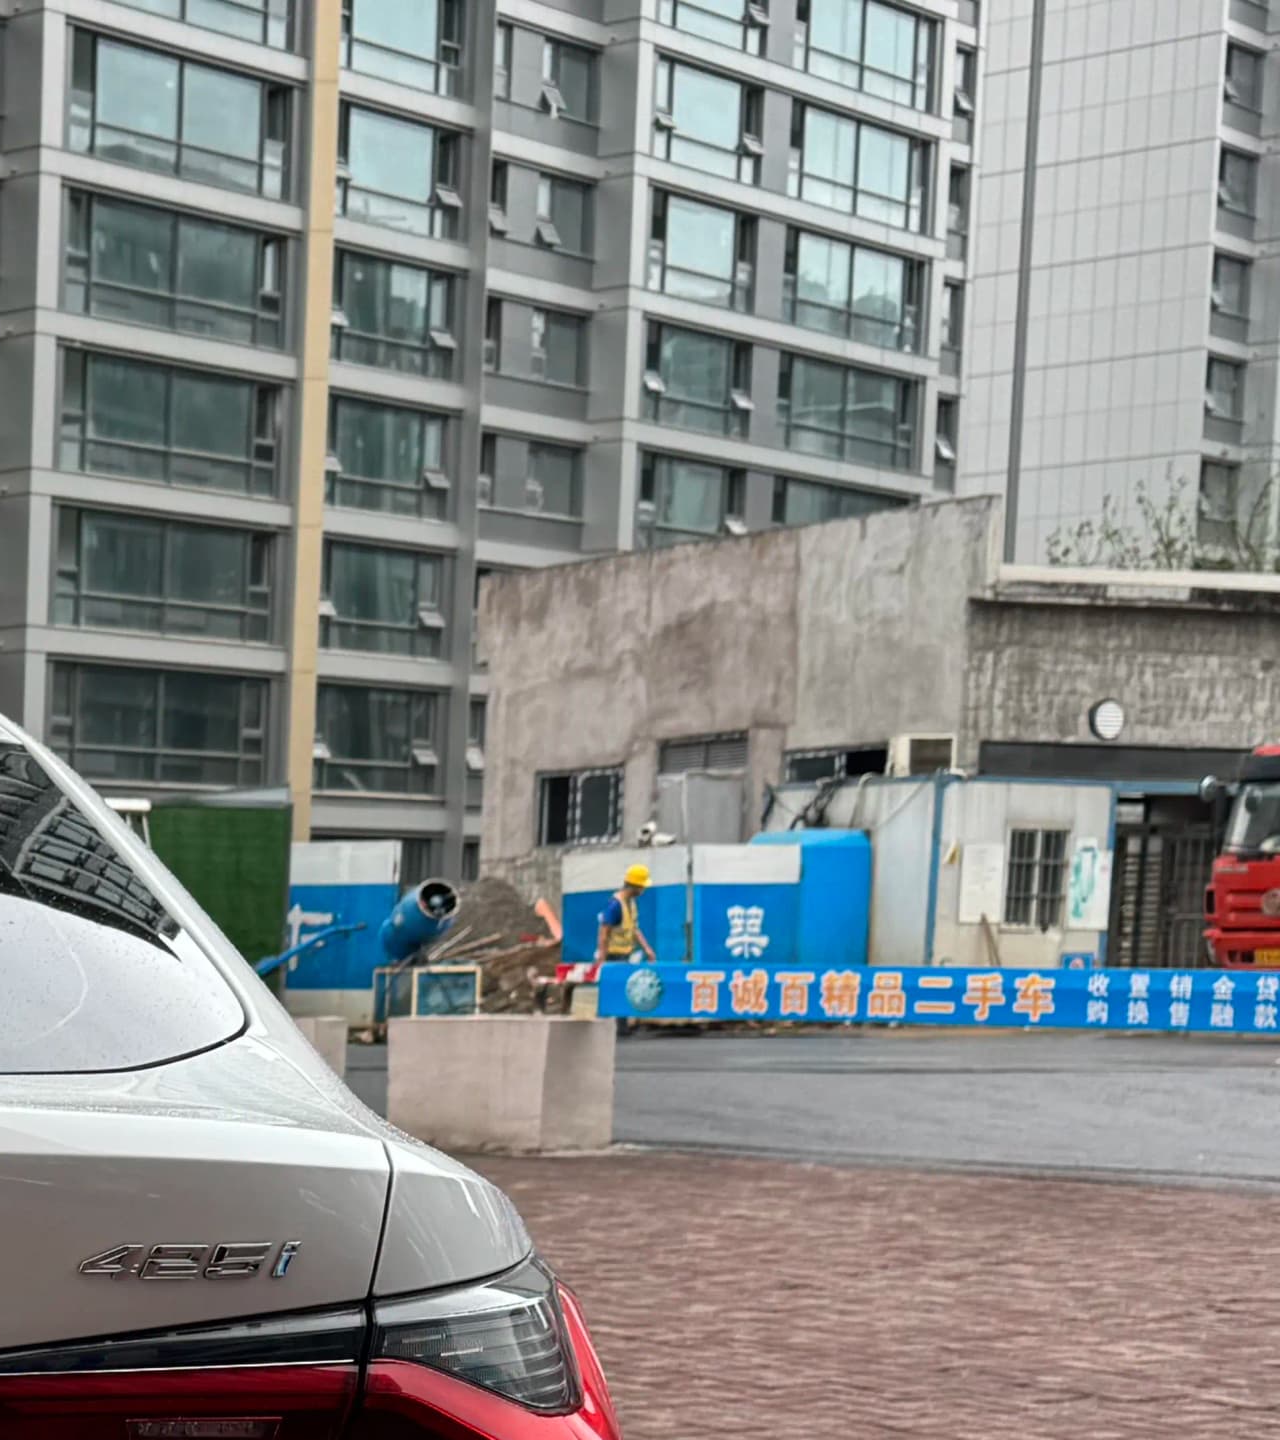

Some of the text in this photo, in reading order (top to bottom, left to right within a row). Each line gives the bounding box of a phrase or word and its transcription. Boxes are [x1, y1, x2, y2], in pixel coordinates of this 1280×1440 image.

[686, 970, 1055, 1022] 百诚百精品二手车
[78, 1241, 301, 1279] 425i
